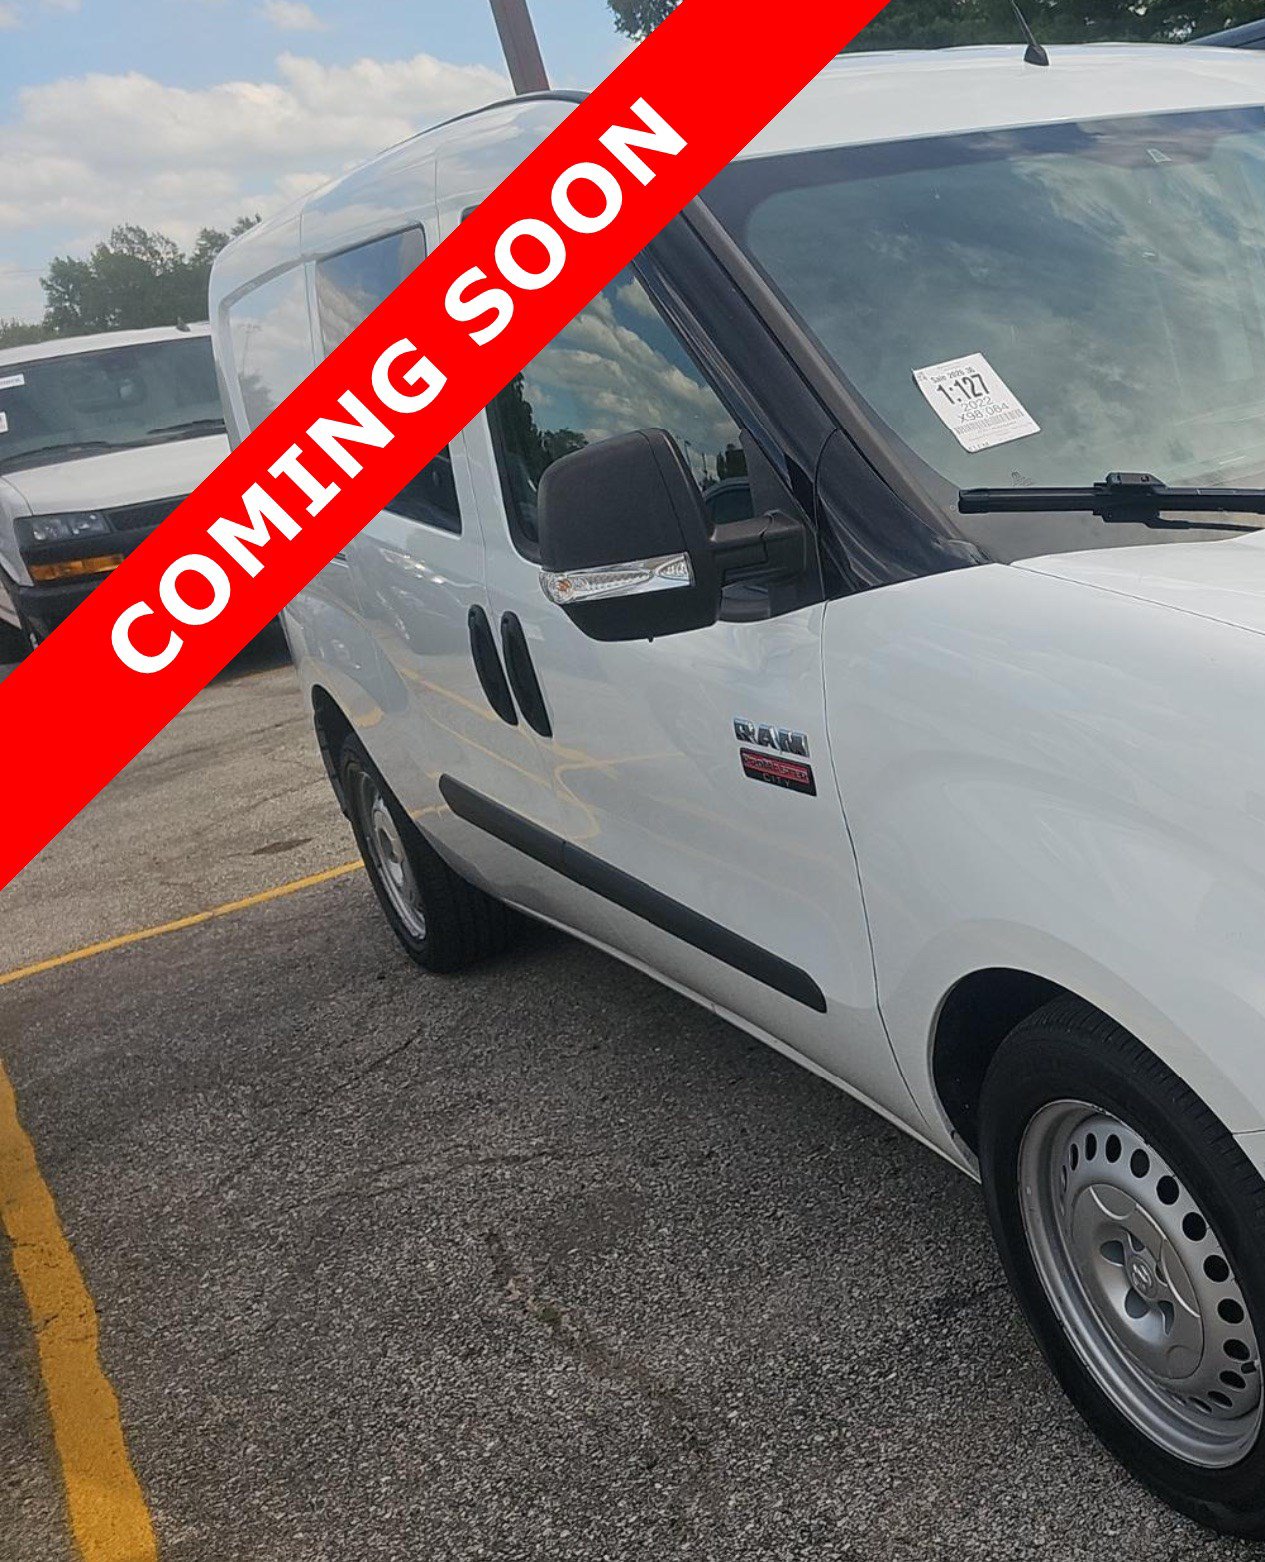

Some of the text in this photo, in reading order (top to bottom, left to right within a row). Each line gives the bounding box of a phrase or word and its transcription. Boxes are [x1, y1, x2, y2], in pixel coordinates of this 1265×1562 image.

[937, 373, 990, 405] 1:127
[961, 396, 993, 412] 2022
[733, 717, 810, 759] RAM
